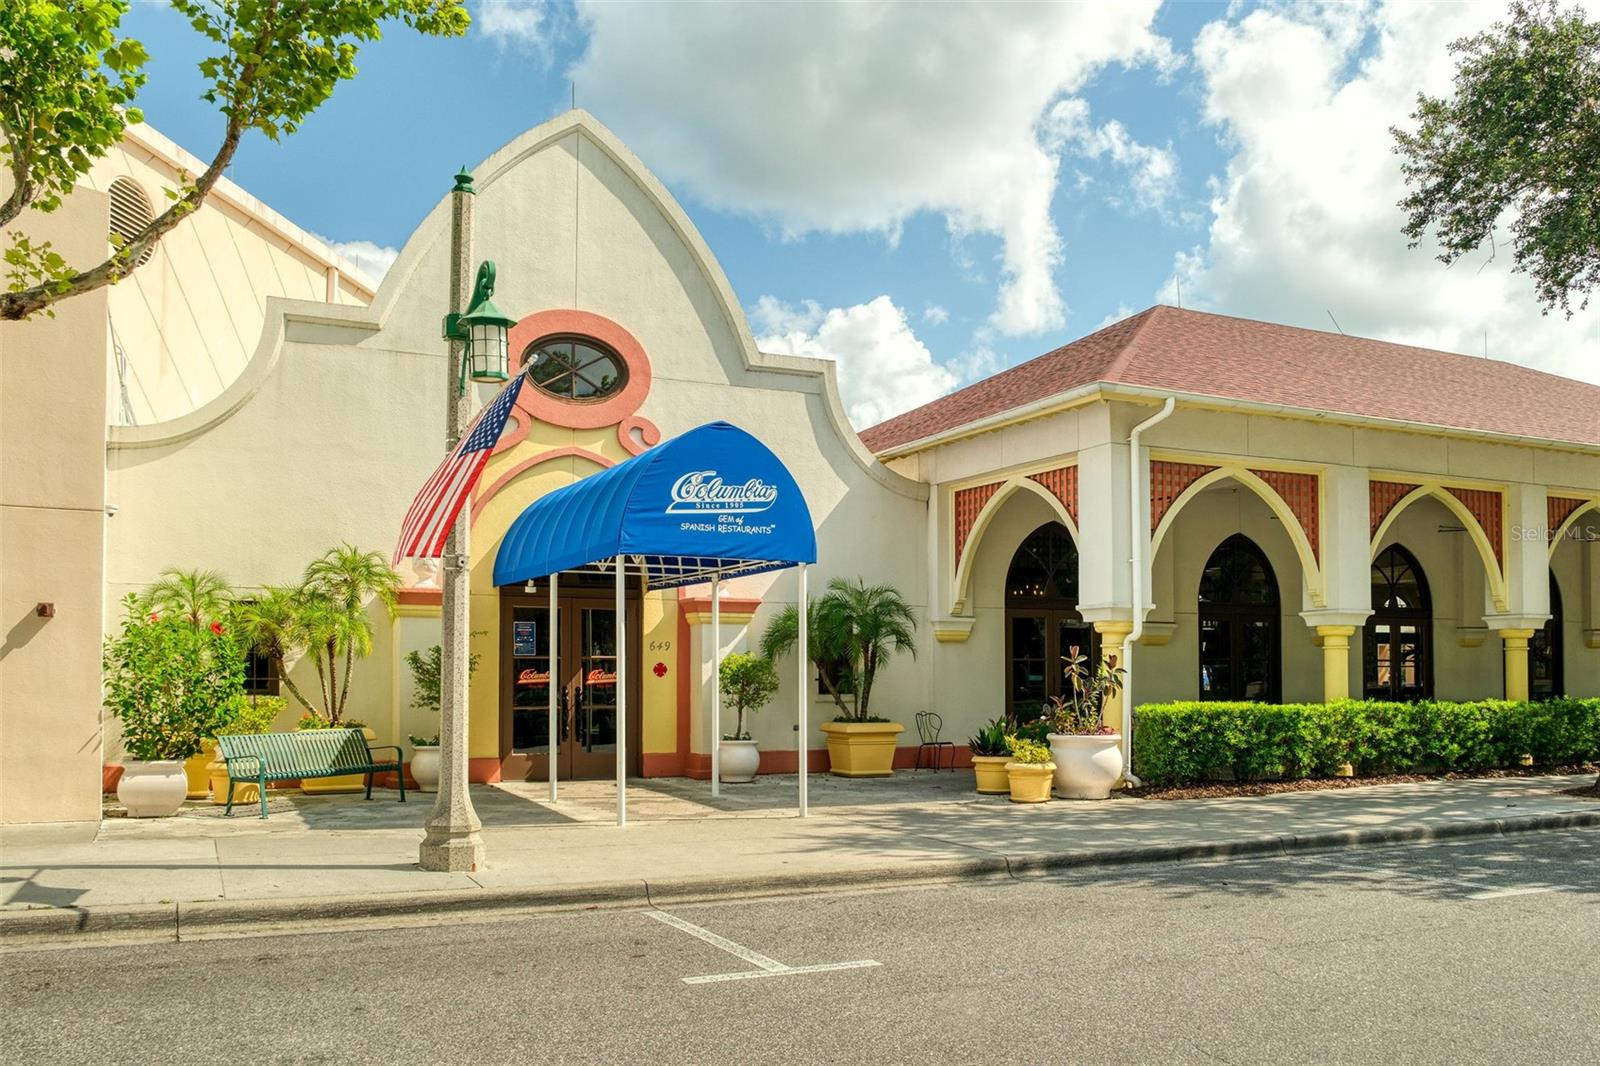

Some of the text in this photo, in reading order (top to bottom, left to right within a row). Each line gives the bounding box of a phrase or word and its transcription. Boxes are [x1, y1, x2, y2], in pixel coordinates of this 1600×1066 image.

[671, 471, 777, 501] Columbia
[718, 515, 745, 524] GEM of
[680, 523, 715, 532] SPANISH
[650, 641, 671, 651] 649
